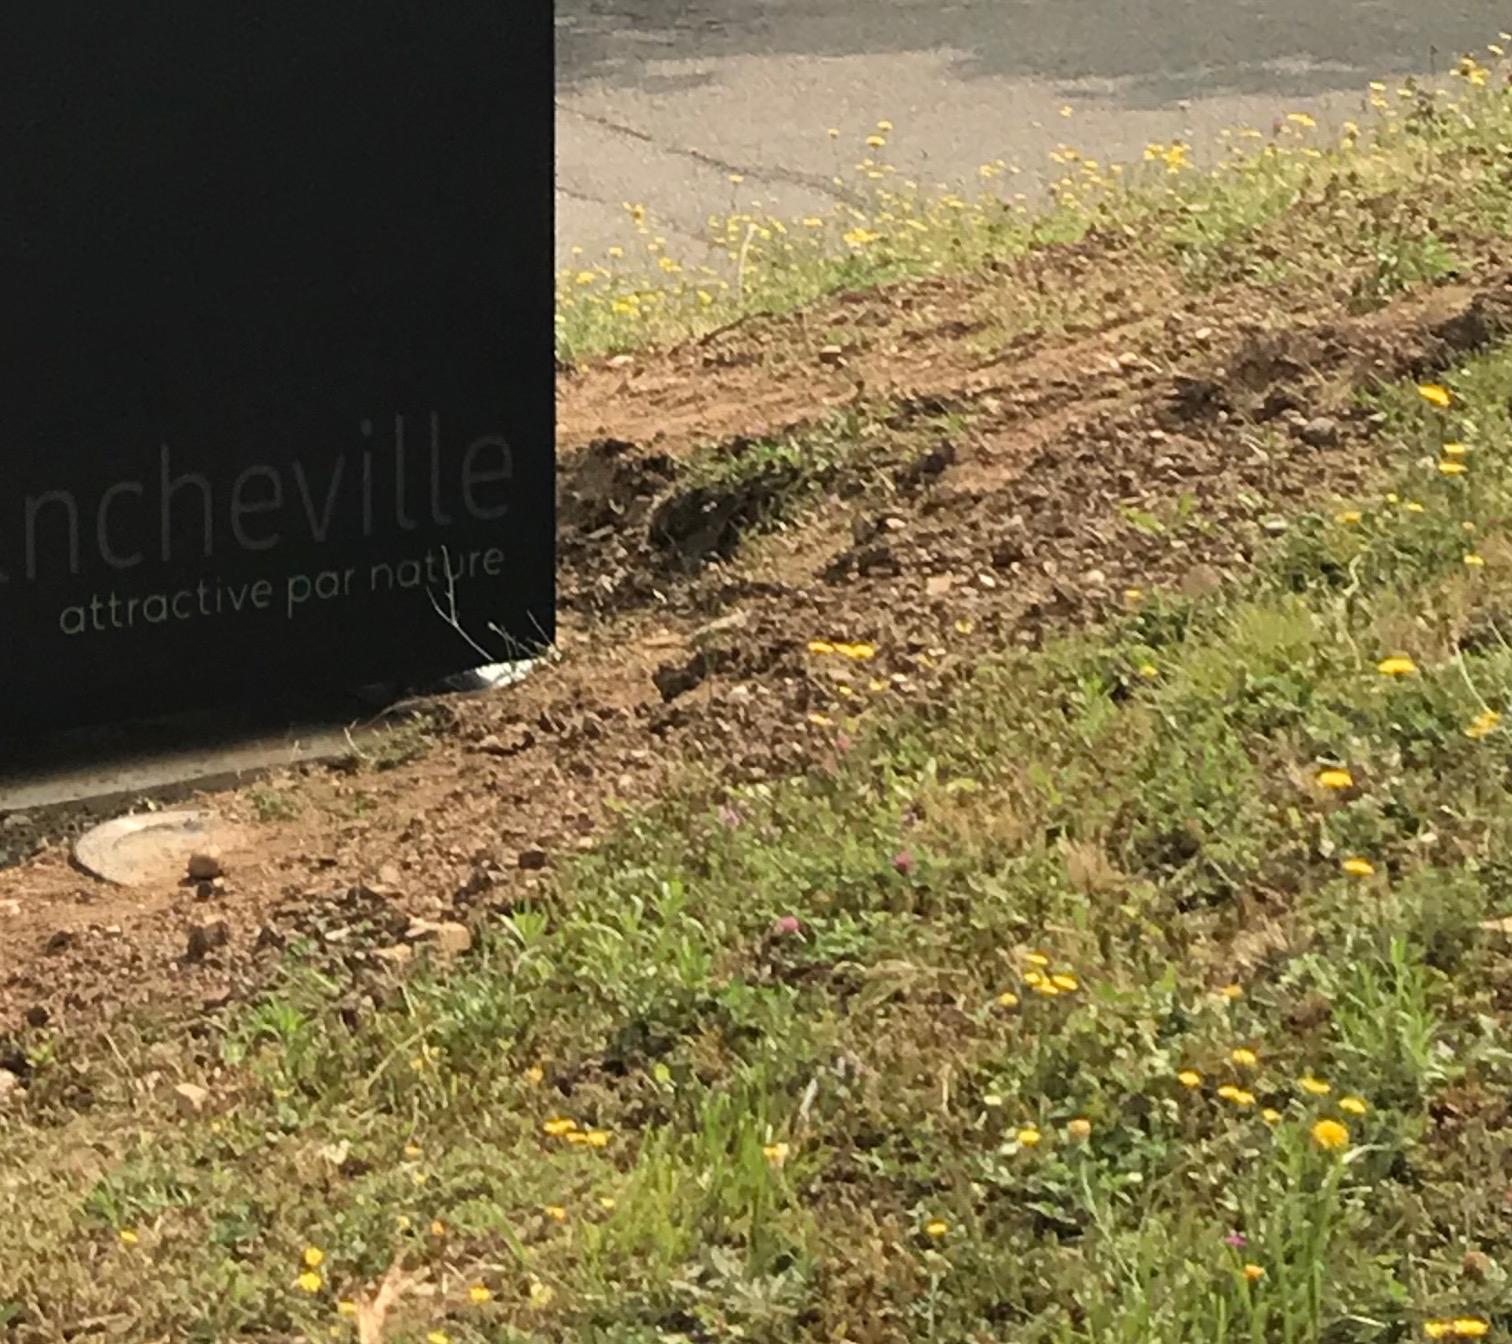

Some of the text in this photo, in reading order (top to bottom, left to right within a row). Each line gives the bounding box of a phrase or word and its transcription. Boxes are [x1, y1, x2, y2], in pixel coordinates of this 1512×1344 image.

[59, 543, 505, 635] attractive par nature
